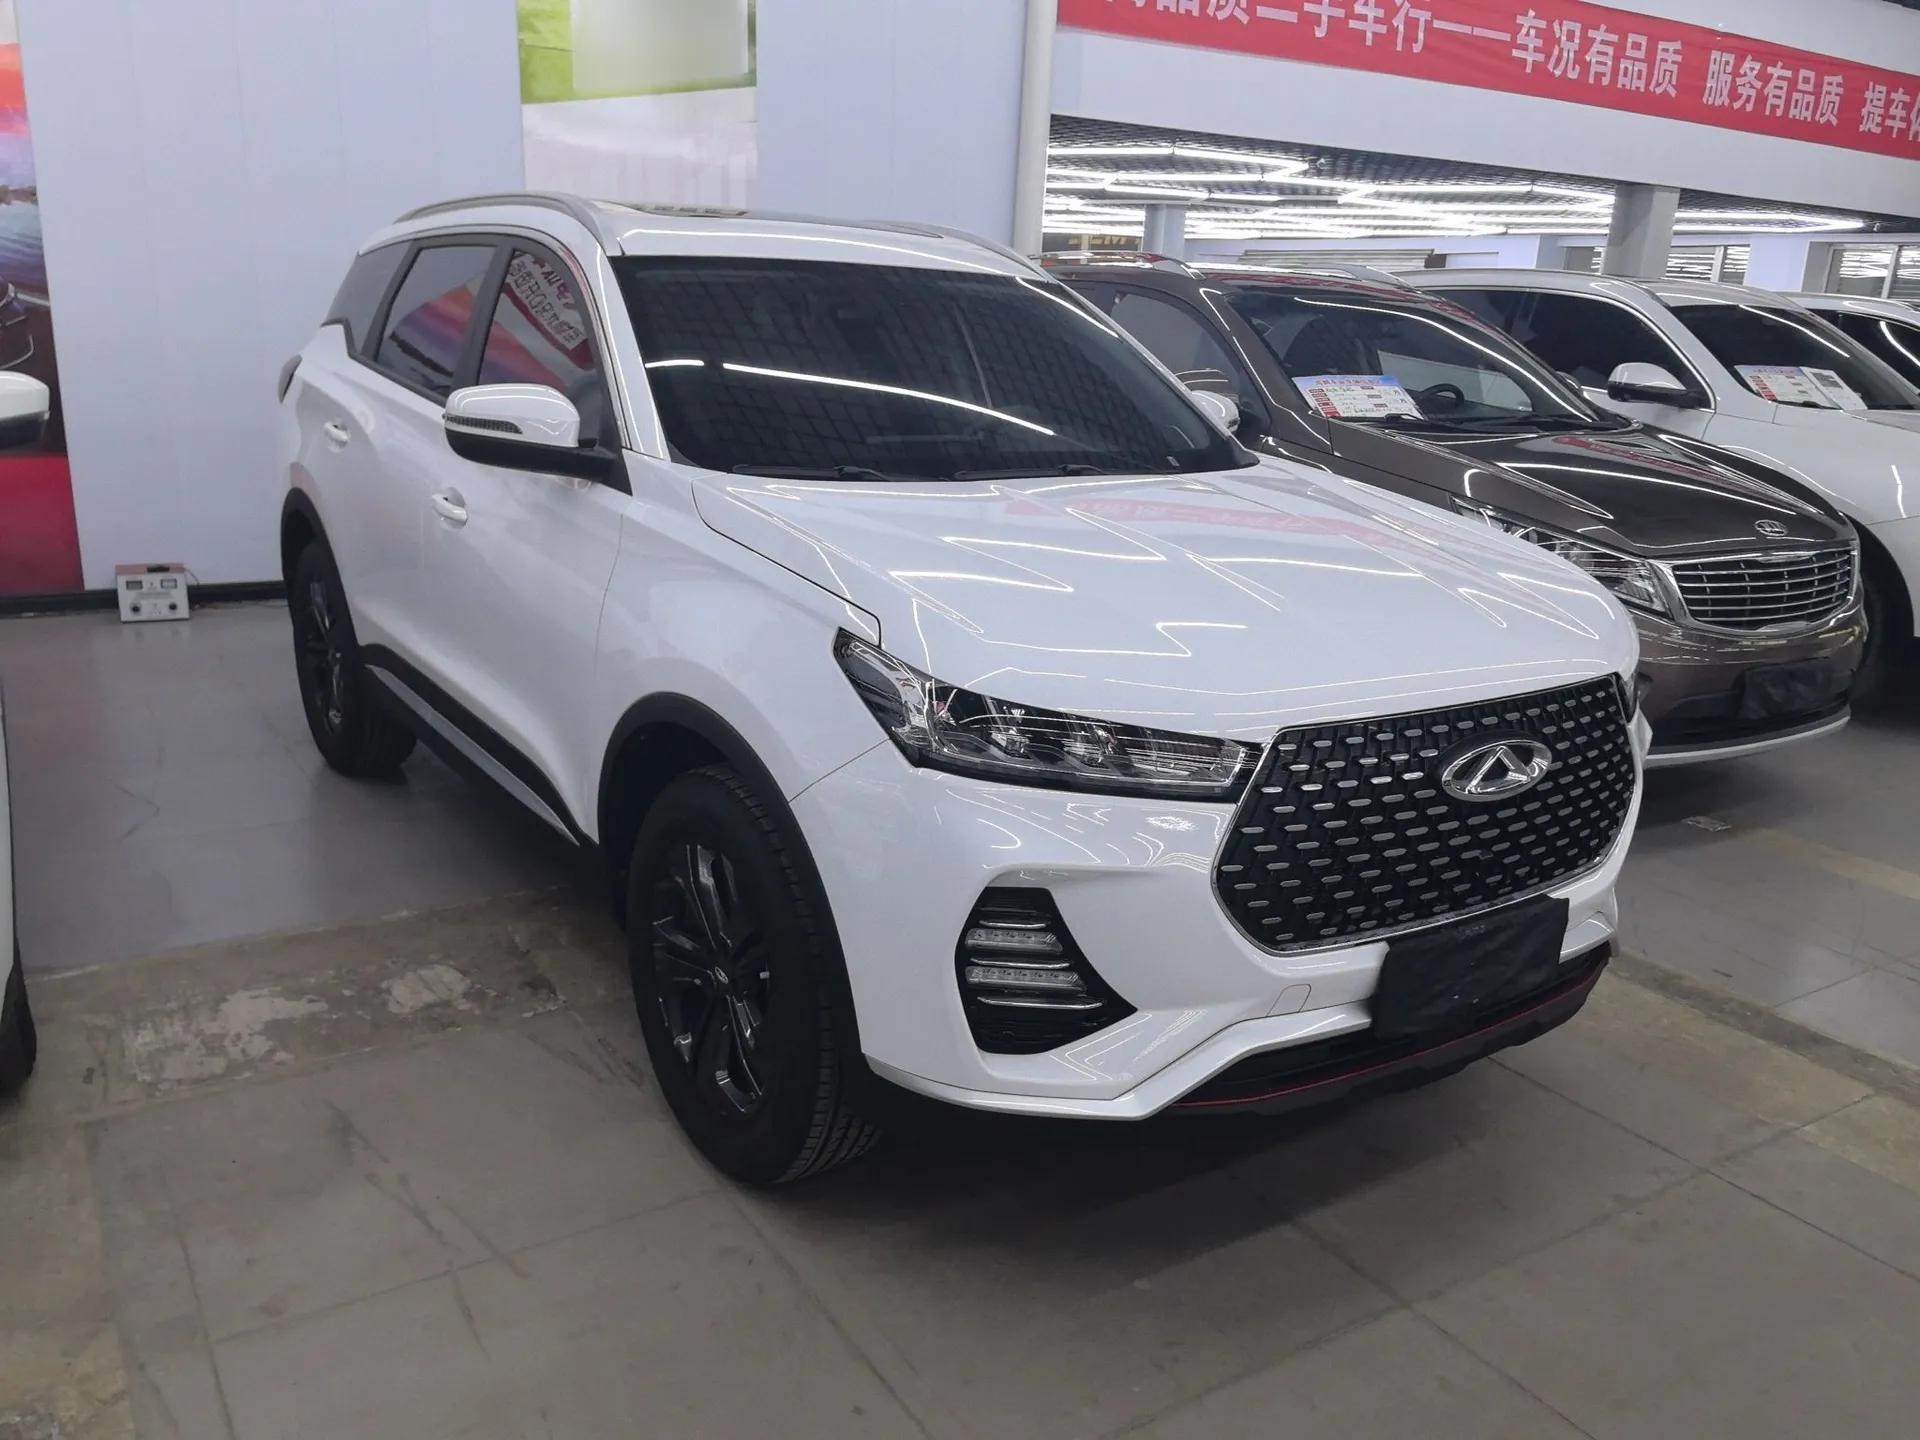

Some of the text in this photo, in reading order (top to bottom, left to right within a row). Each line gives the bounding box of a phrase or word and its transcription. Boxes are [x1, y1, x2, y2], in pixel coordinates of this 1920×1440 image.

[1702, 50, 1845, 127] 服务有品质
